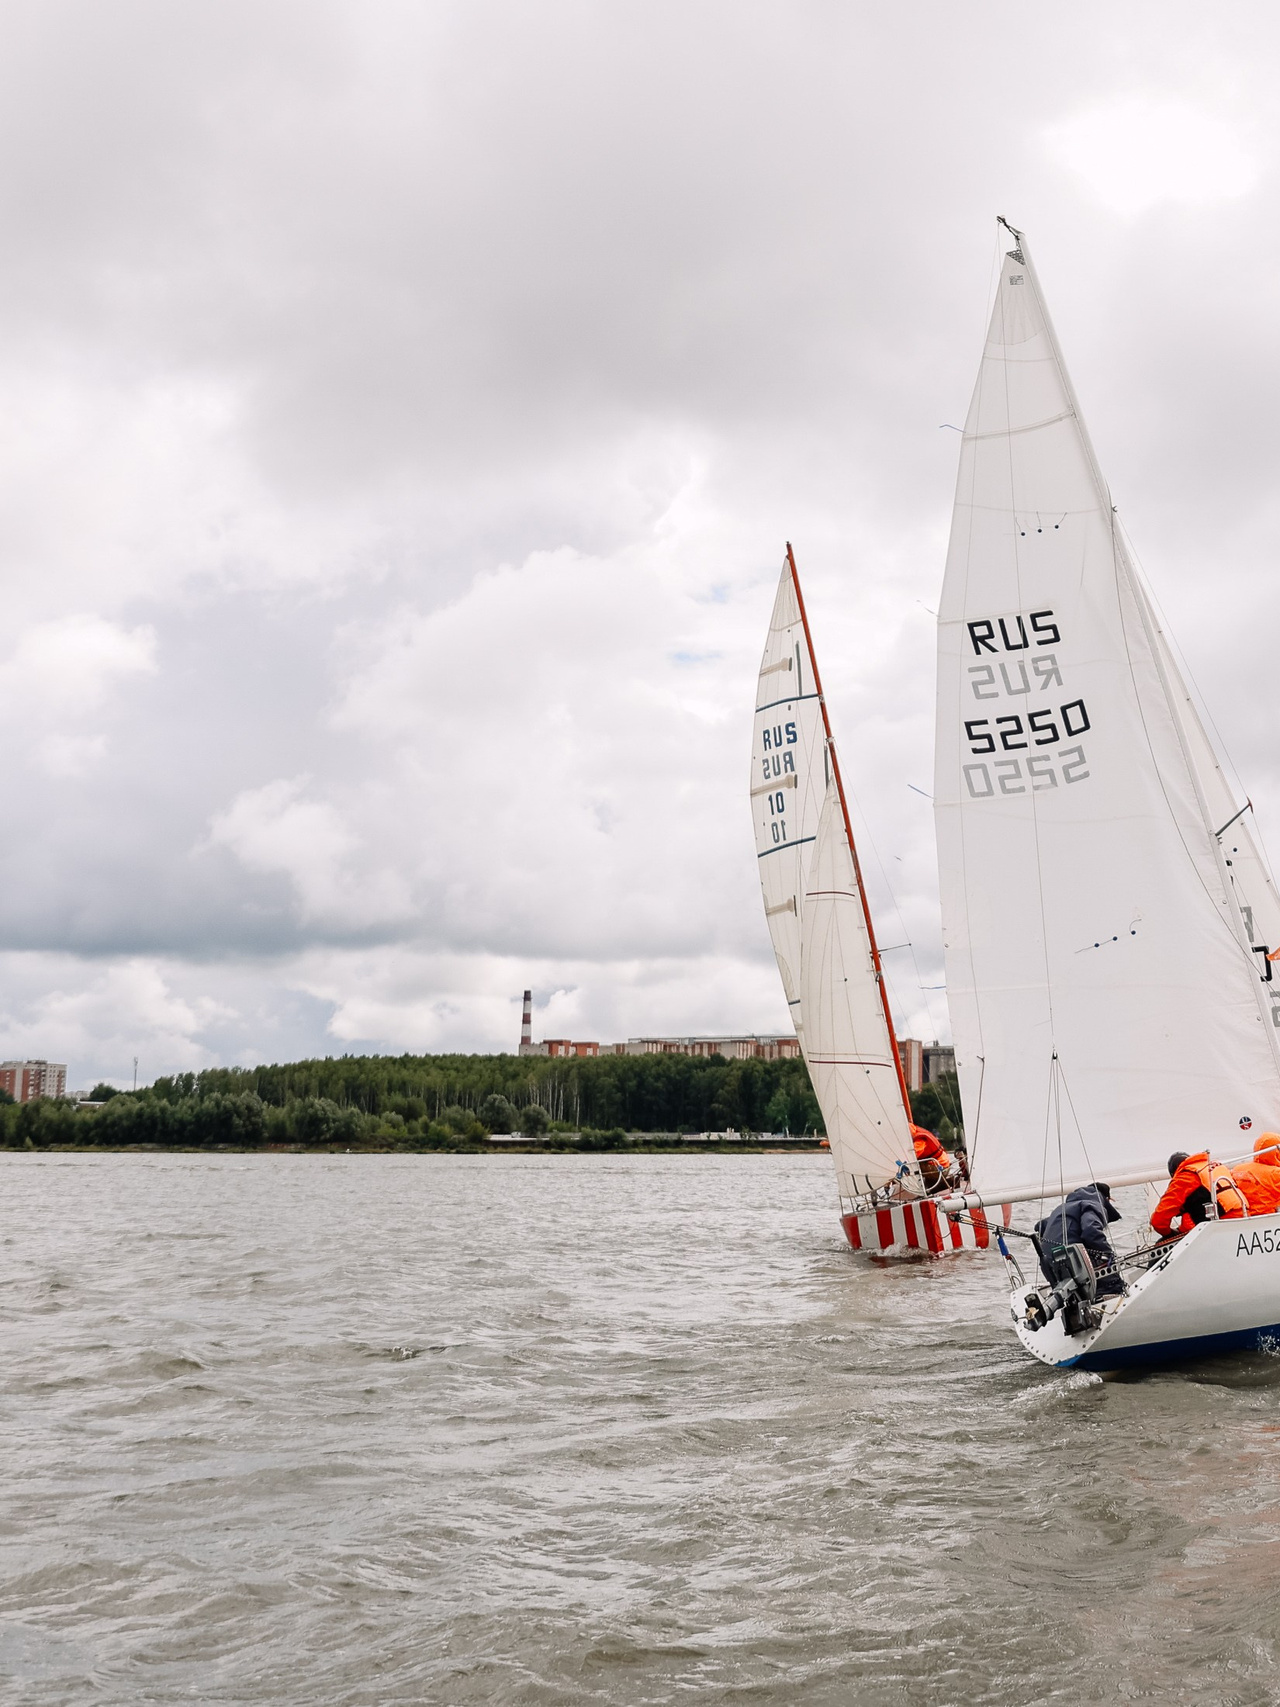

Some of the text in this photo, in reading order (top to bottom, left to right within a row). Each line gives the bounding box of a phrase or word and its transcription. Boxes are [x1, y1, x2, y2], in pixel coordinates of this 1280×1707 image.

[967, 610, 1061, 655] RUS
[762, 722, 798, 751] RUS
[964, 698, 1091, 754] 5250
[768, 791, 785, 816] 10
